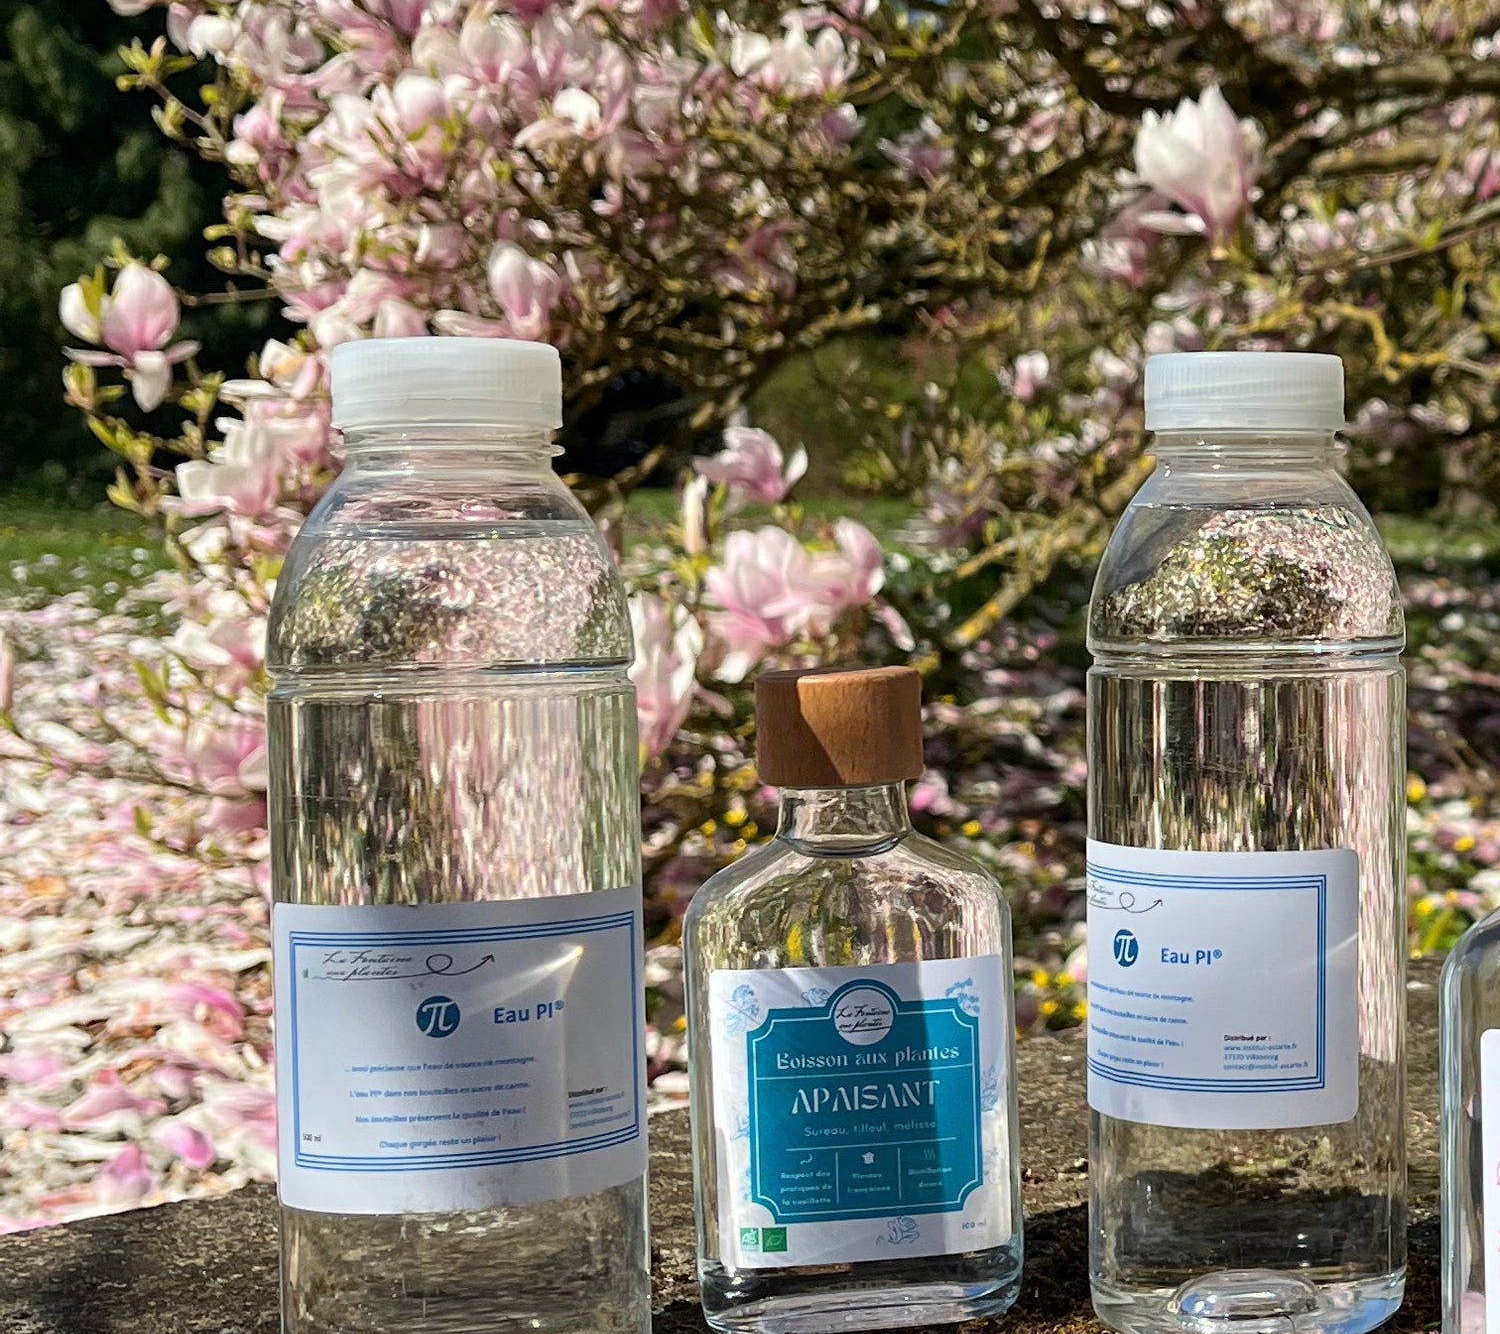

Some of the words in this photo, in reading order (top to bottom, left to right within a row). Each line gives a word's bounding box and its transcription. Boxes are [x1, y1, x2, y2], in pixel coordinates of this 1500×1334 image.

[349, 950, 413, 964] Fontaine
[1161, 947, 1190, 964] Eau
[494, 1007, 529, 1024] Eau
[777, 1052, 848, 1070] Boisson
[855, 1051, 887, 1066] aux
[895, 1046, 960, 1067] plantes
[791, 1080, 941, 1115] APAISANT
[804, 1126, 849, 1137] Sureau,
[894, 1120, 937, 1131] mélisse
